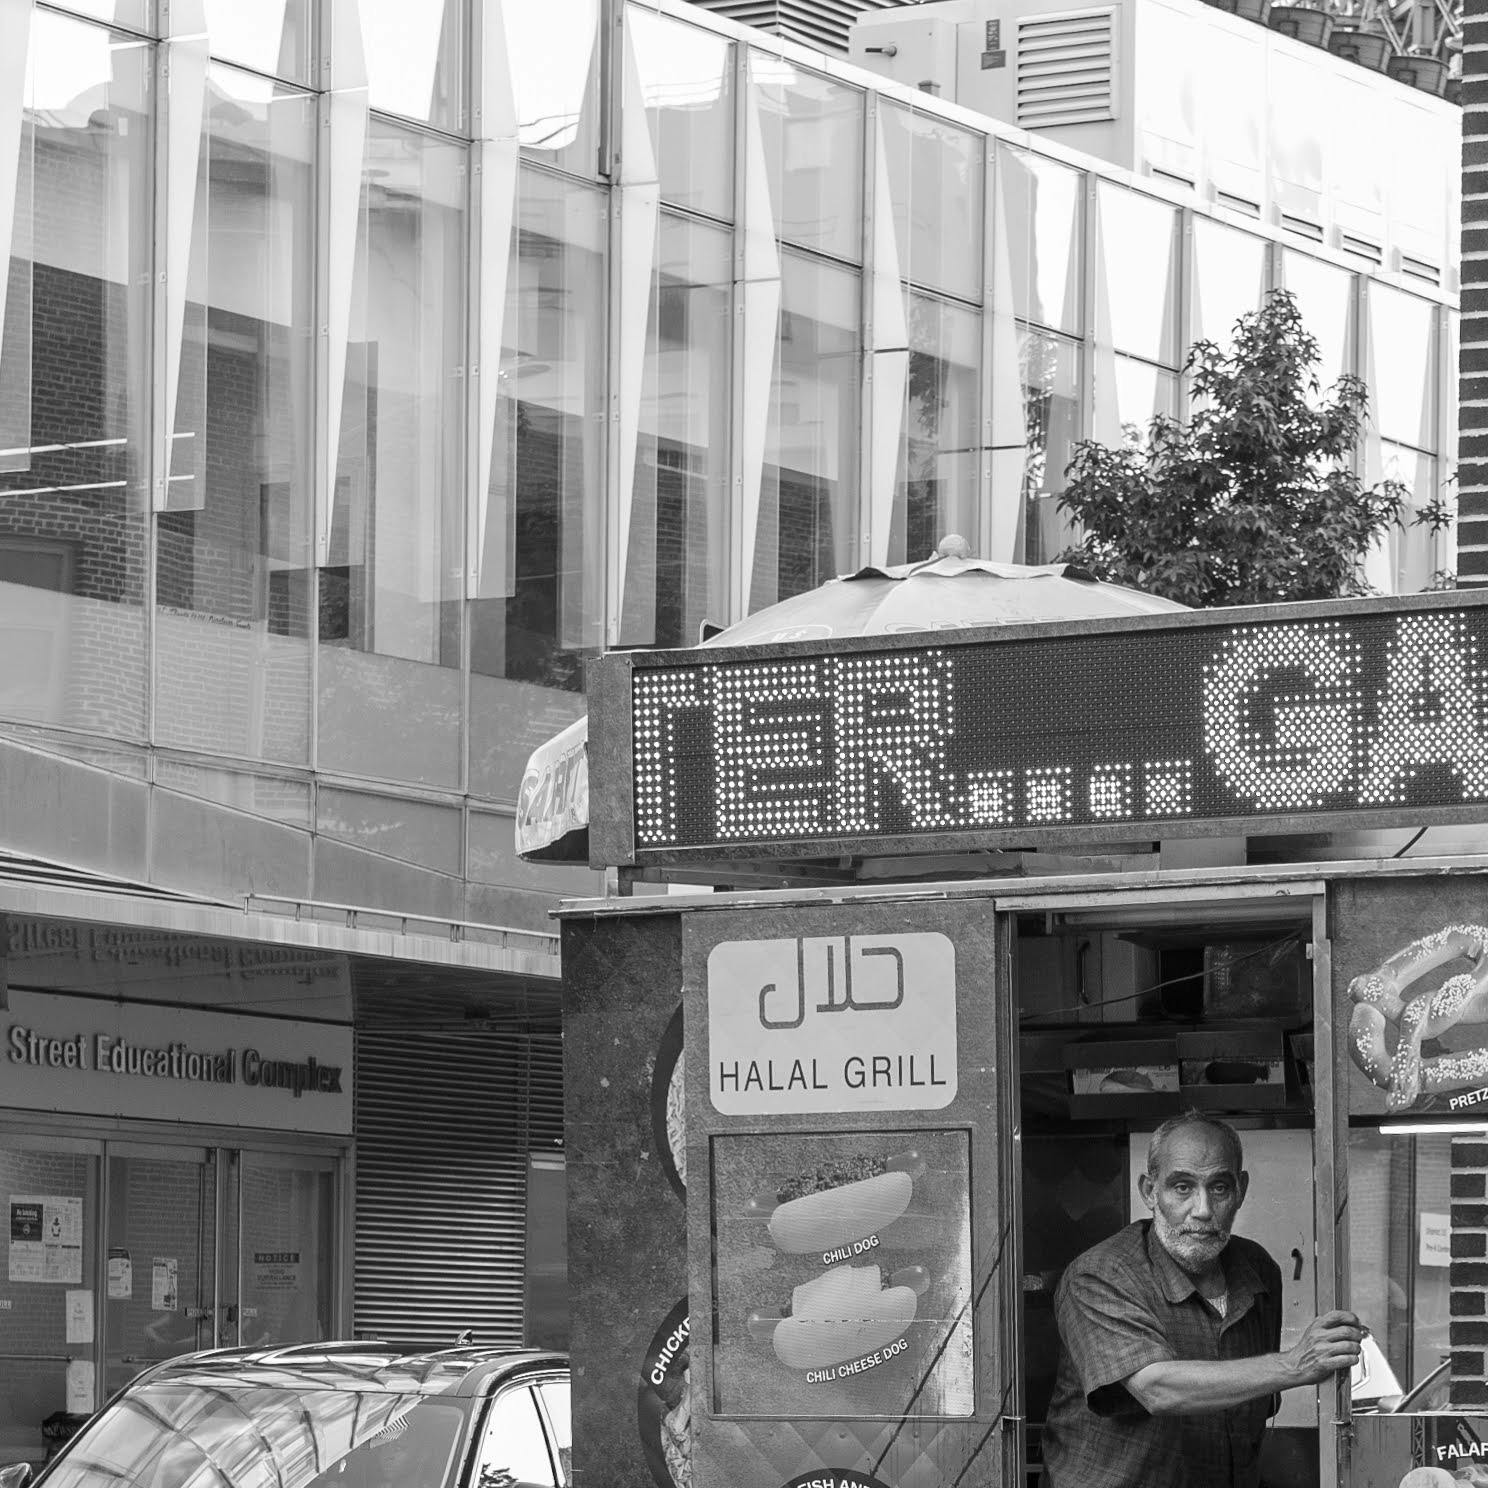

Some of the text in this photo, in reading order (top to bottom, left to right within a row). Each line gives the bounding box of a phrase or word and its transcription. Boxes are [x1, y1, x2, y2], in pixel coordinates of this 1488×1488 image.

[9, 1025, 343, 1098] Street Educational Complex
[719, 1055, 946, 1092] HALAL GRILL
[823, 1234, 880, 1266] CHILI DOG
[806, 1338, 909, 1384] CHILI CHEESE DOG
